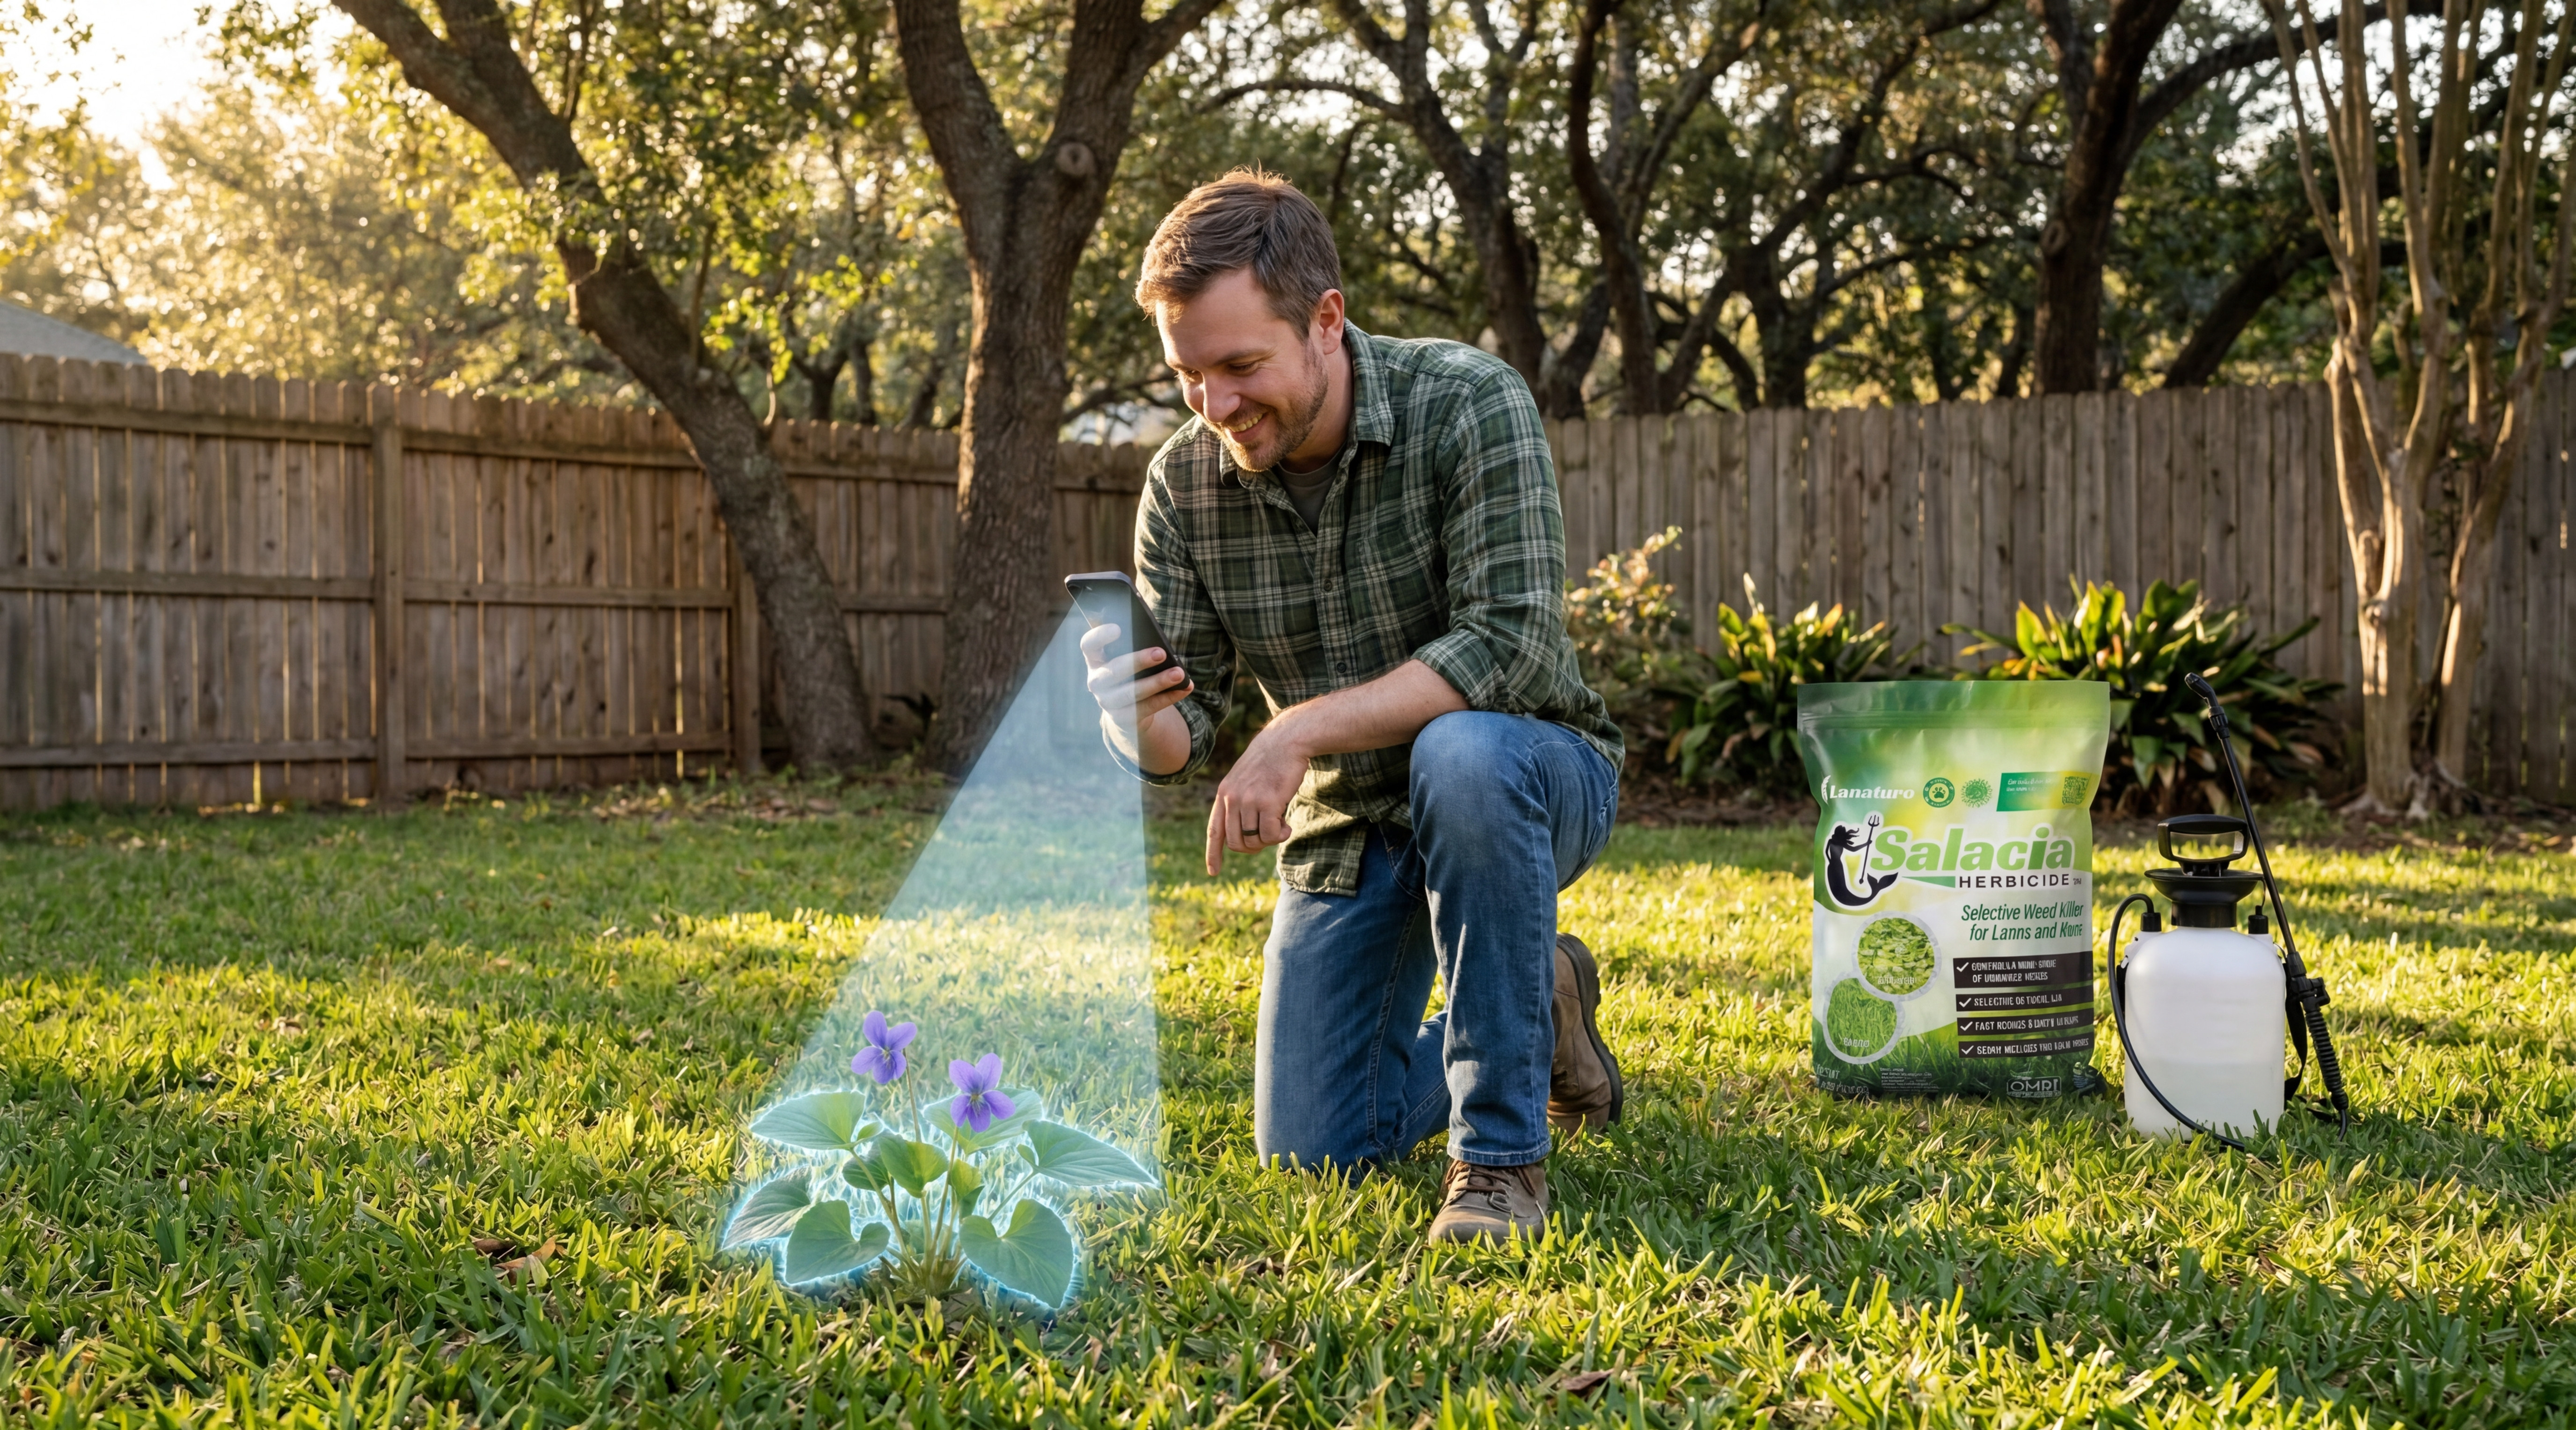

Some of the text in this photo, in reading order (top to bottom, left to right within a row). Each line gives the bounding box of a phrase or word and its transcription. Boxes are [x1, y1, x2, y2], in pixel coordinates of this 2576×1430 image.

[1830, 785, 1915, 799] Lanaturo
[1870, 827, 2072, 871] Salacia
[1959, 874, 2069, 888] HERBICIDE
[1961, 904, 2021, 921] Selective
[2024, 902, 2057, 919] Weed
[1970, 923, 1989, 941] for
[1991, 924, 2031, 941] Lanns
[2034, 921, 2057, 939] and
[1972, 974, 1983, 983] OF
[2011, 1079, 2058, 1092] OMRI
